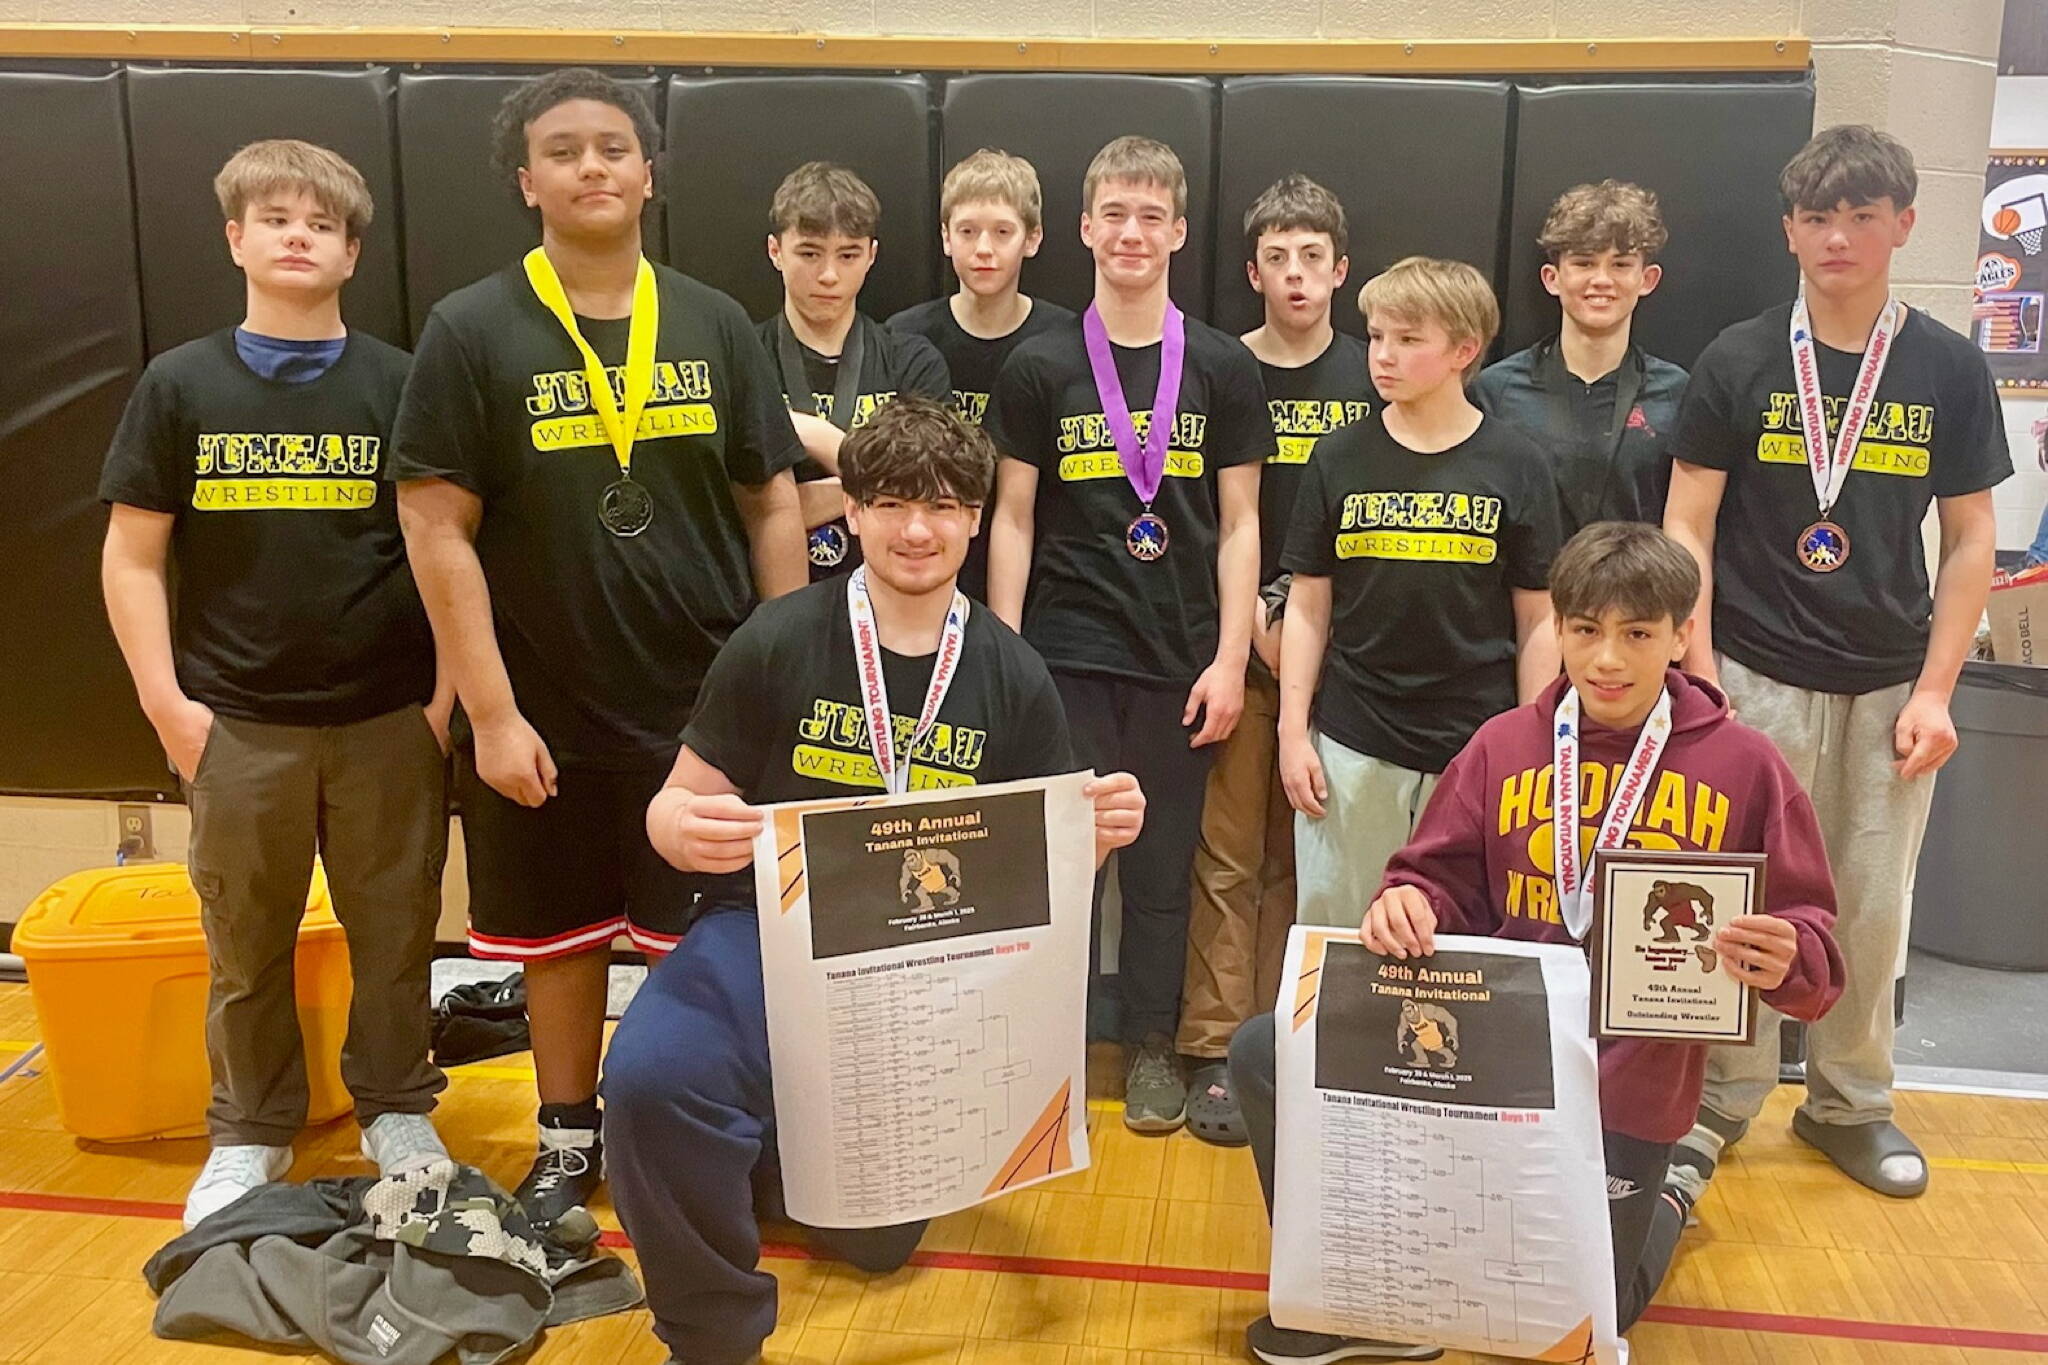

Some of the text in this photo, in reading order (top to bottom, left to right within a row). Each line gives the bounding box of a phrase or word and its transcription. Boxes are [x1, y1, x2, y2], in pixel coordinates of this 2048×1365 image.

[1855, 328, 1888, 404] TOURNAMENT
[195, 432, 381, 475] JUNEAU
[195, 484, 376, 504] WRESTLING
[1340, 492, 1502, 535] JUNEAU
[1337, 537, 1494, 559] WRESTLING
[2018, 604, 2031, 638] BELL
[1611, 736, 1660, 825] TOURNAMENT
[871, 810, 982, 836] 49th Annual
[1559, 744, 1576, 896] TANANA INVITATIONAL
[865, 827, 989, 853] Tanana Invitational
[826, 970, 857, 980] Tanana
[857, 961, 905, 976] Invitational
[905, 955, 945, 969] Wrestling
[946, 947, 994, 961] Tournament
[1378, 963, 1483, 985] 49th Annual
[1370, 982, 1491, 1001] Tanana Invitational
[1632, 993, 1717, 1006] Tanana Invitational
[1670, 984, 1702, 994] Annual
[1627, 1010, 1721, 1021] Outstanding Wrestler
[1322, 1092, 1351, 1104] Tanana
[1353, 1095, 1399, 1111] Invitational
[1400, 1102, 1442, 1117] Wrestling
[1443, 1107, 1498, 1121] Tournament
